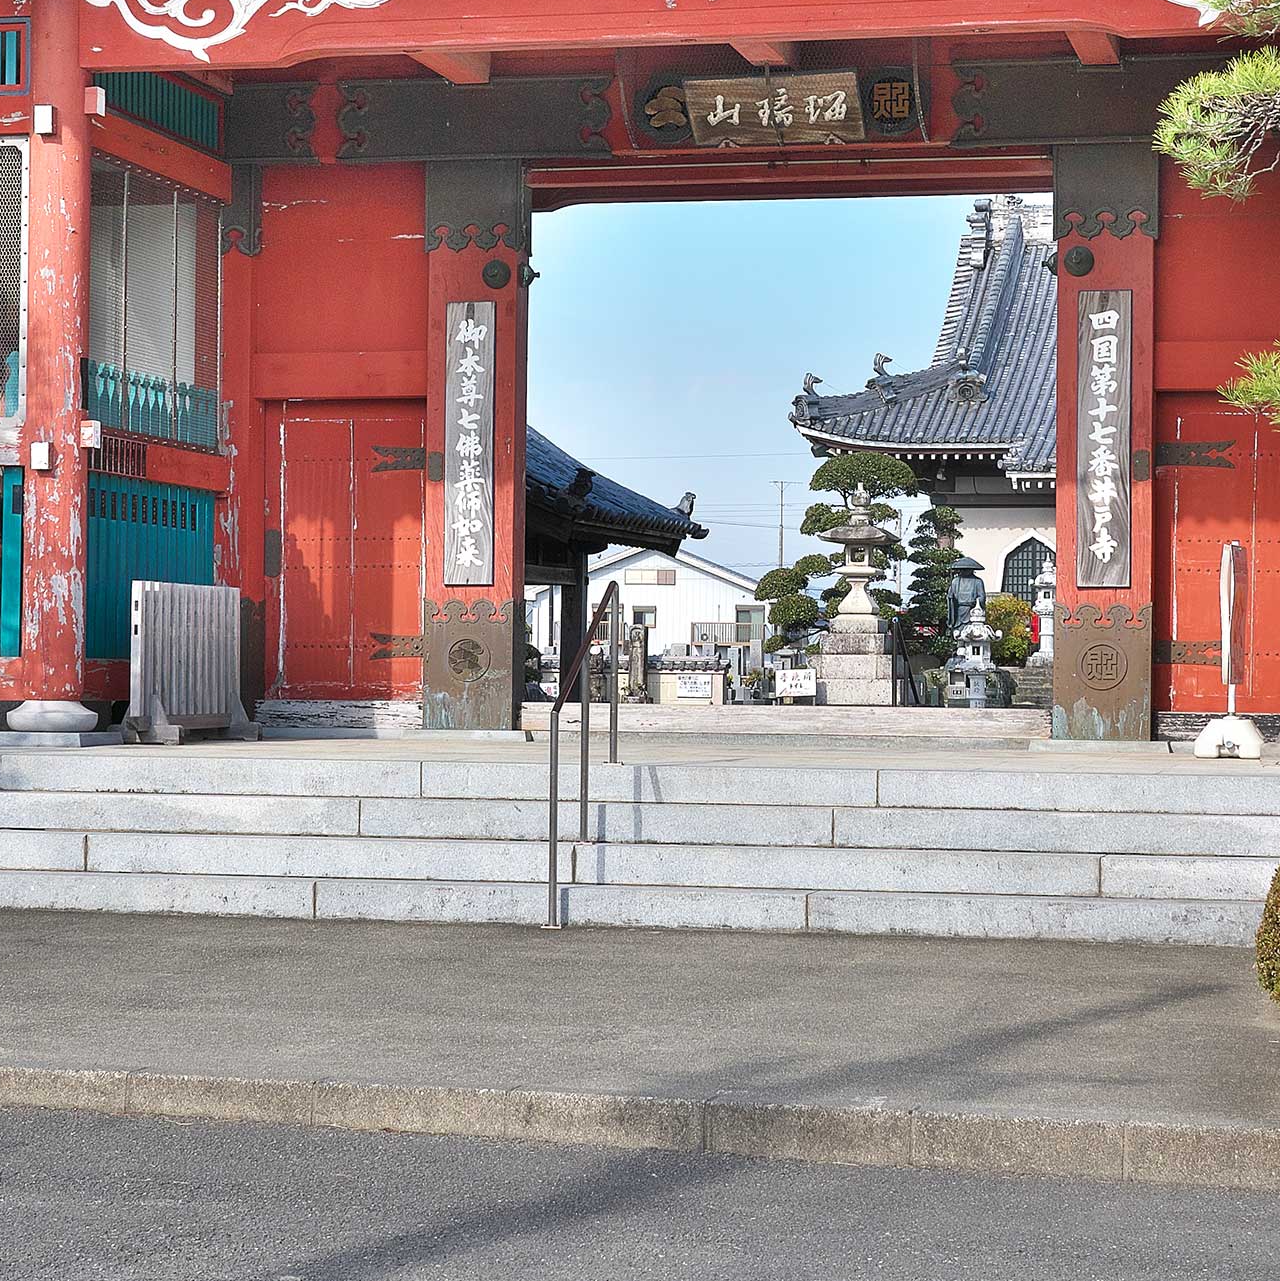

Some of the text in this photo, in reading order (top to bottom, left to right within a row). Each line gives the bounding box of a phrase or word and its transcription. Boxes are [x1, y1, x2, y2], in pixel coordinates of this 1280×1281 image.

[451, 319, 487, 567] 御本尊七佛薬師如来
[1088, 310, 1119, 564] 四国第十七番井戸寺
